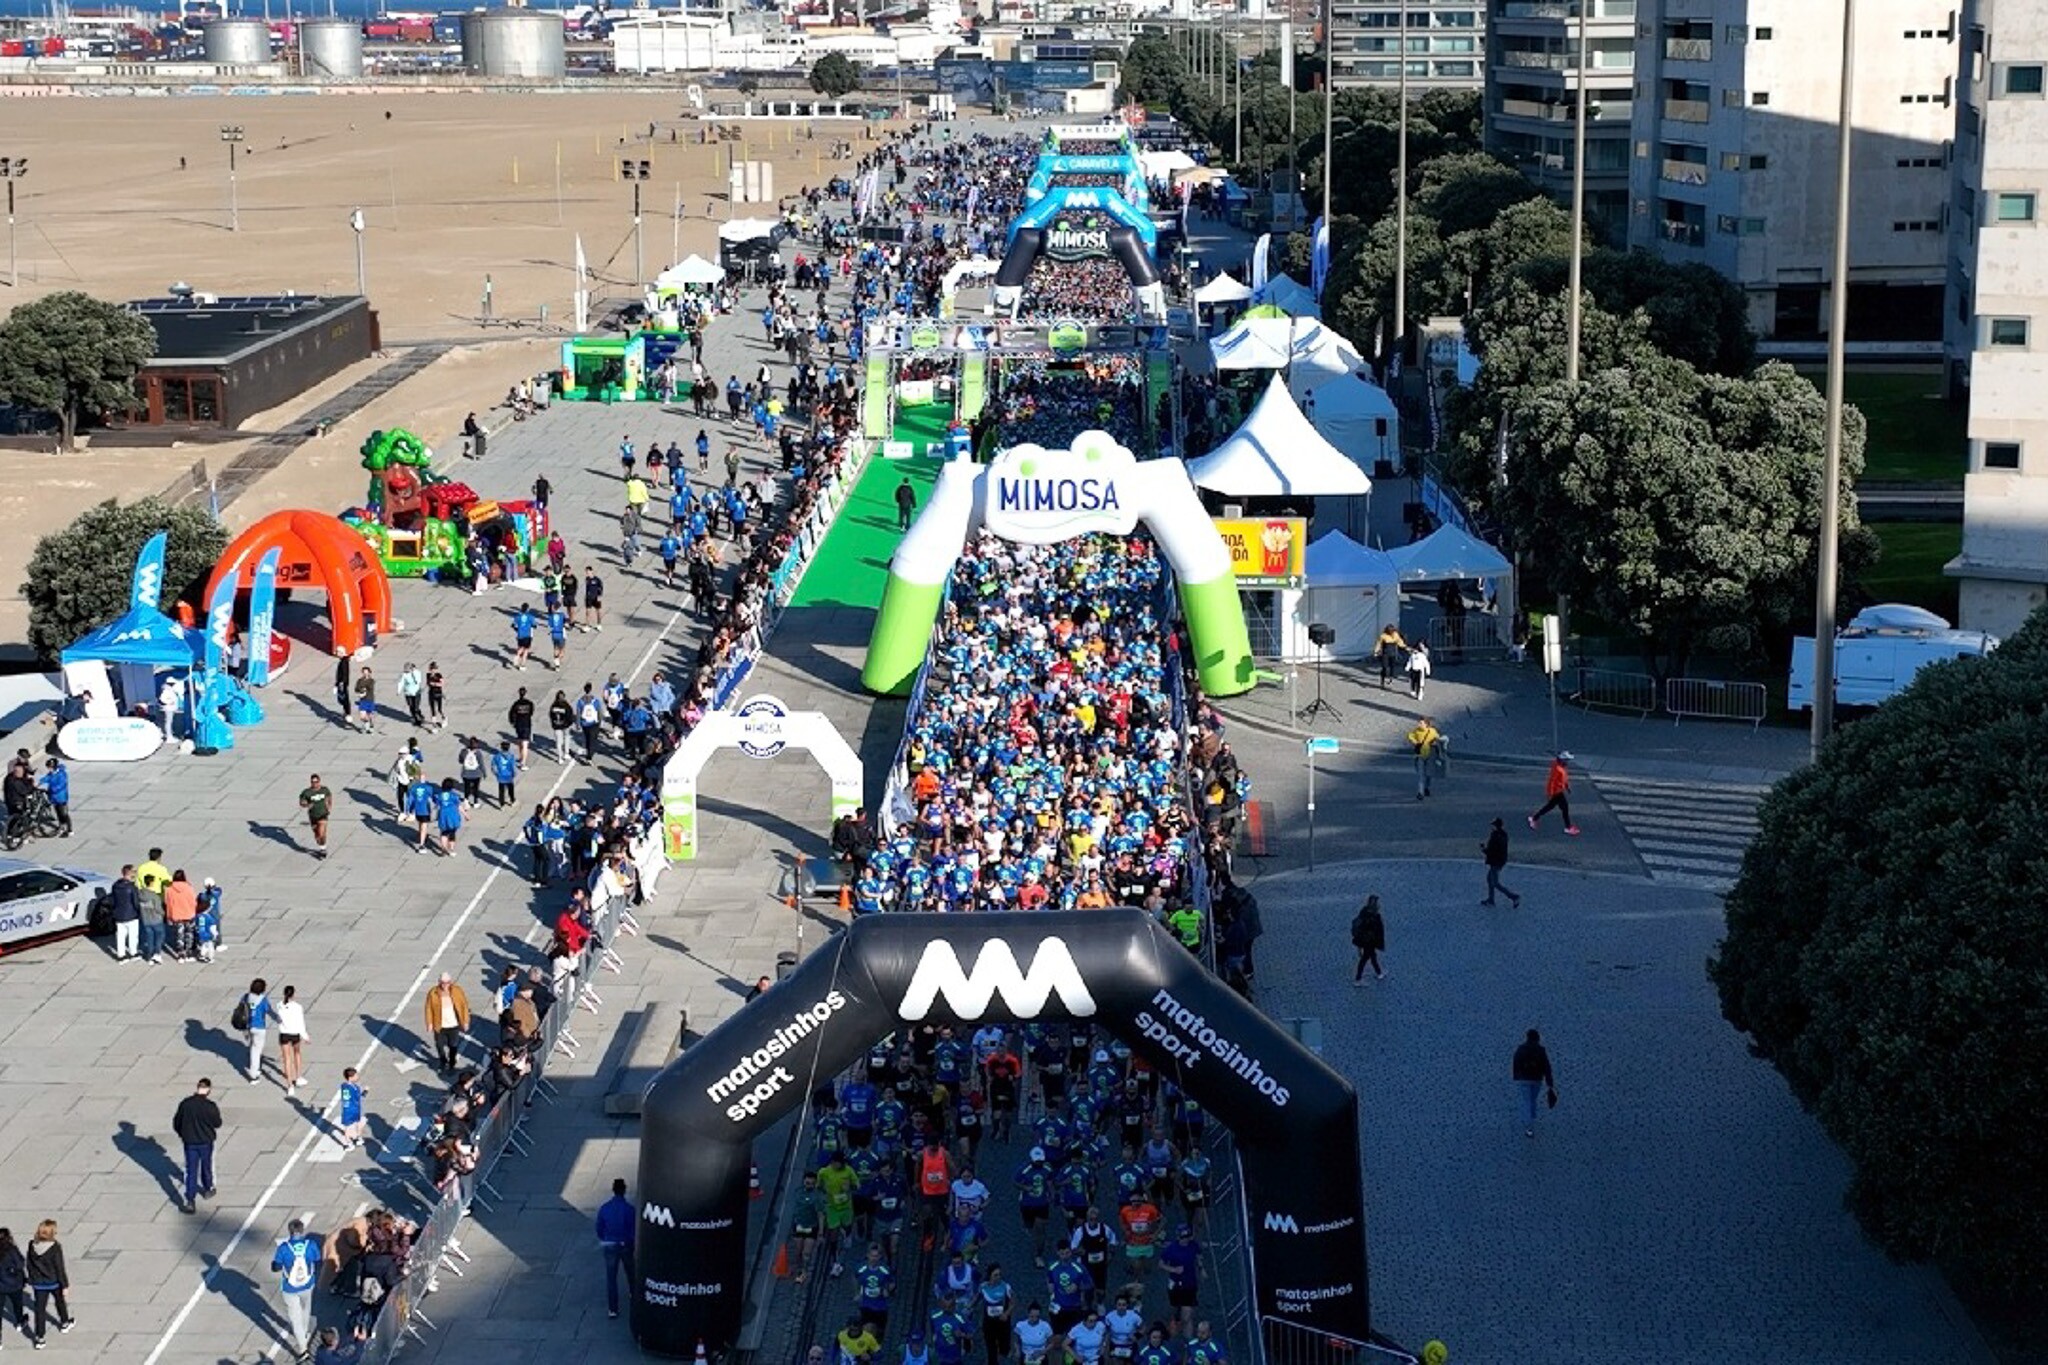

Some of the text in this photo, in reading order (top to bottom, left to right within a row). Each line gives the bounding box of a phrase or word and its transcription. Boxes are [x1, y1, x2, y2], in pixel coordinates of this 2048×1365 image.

[1047, 230, 1109, 249] MIMOSA
[1000, 478, 1120, 511] MIMOSA
[35, 911, 43, 925] 5
[707, 990, 846, 1104] matosinhos
[1135, 1011, 1201, 1069] sport
[1152, 989, 1291, 1106] matosinhos
[726, 1065, 795, 1122] sport
[645, 1278, 721, 1295] matosinhos
[1276, 1283, 1353, 1300] matosinhos
[645, 1290, 678, 1307] sport
[1276, 1301, 1312, 1313] sport
